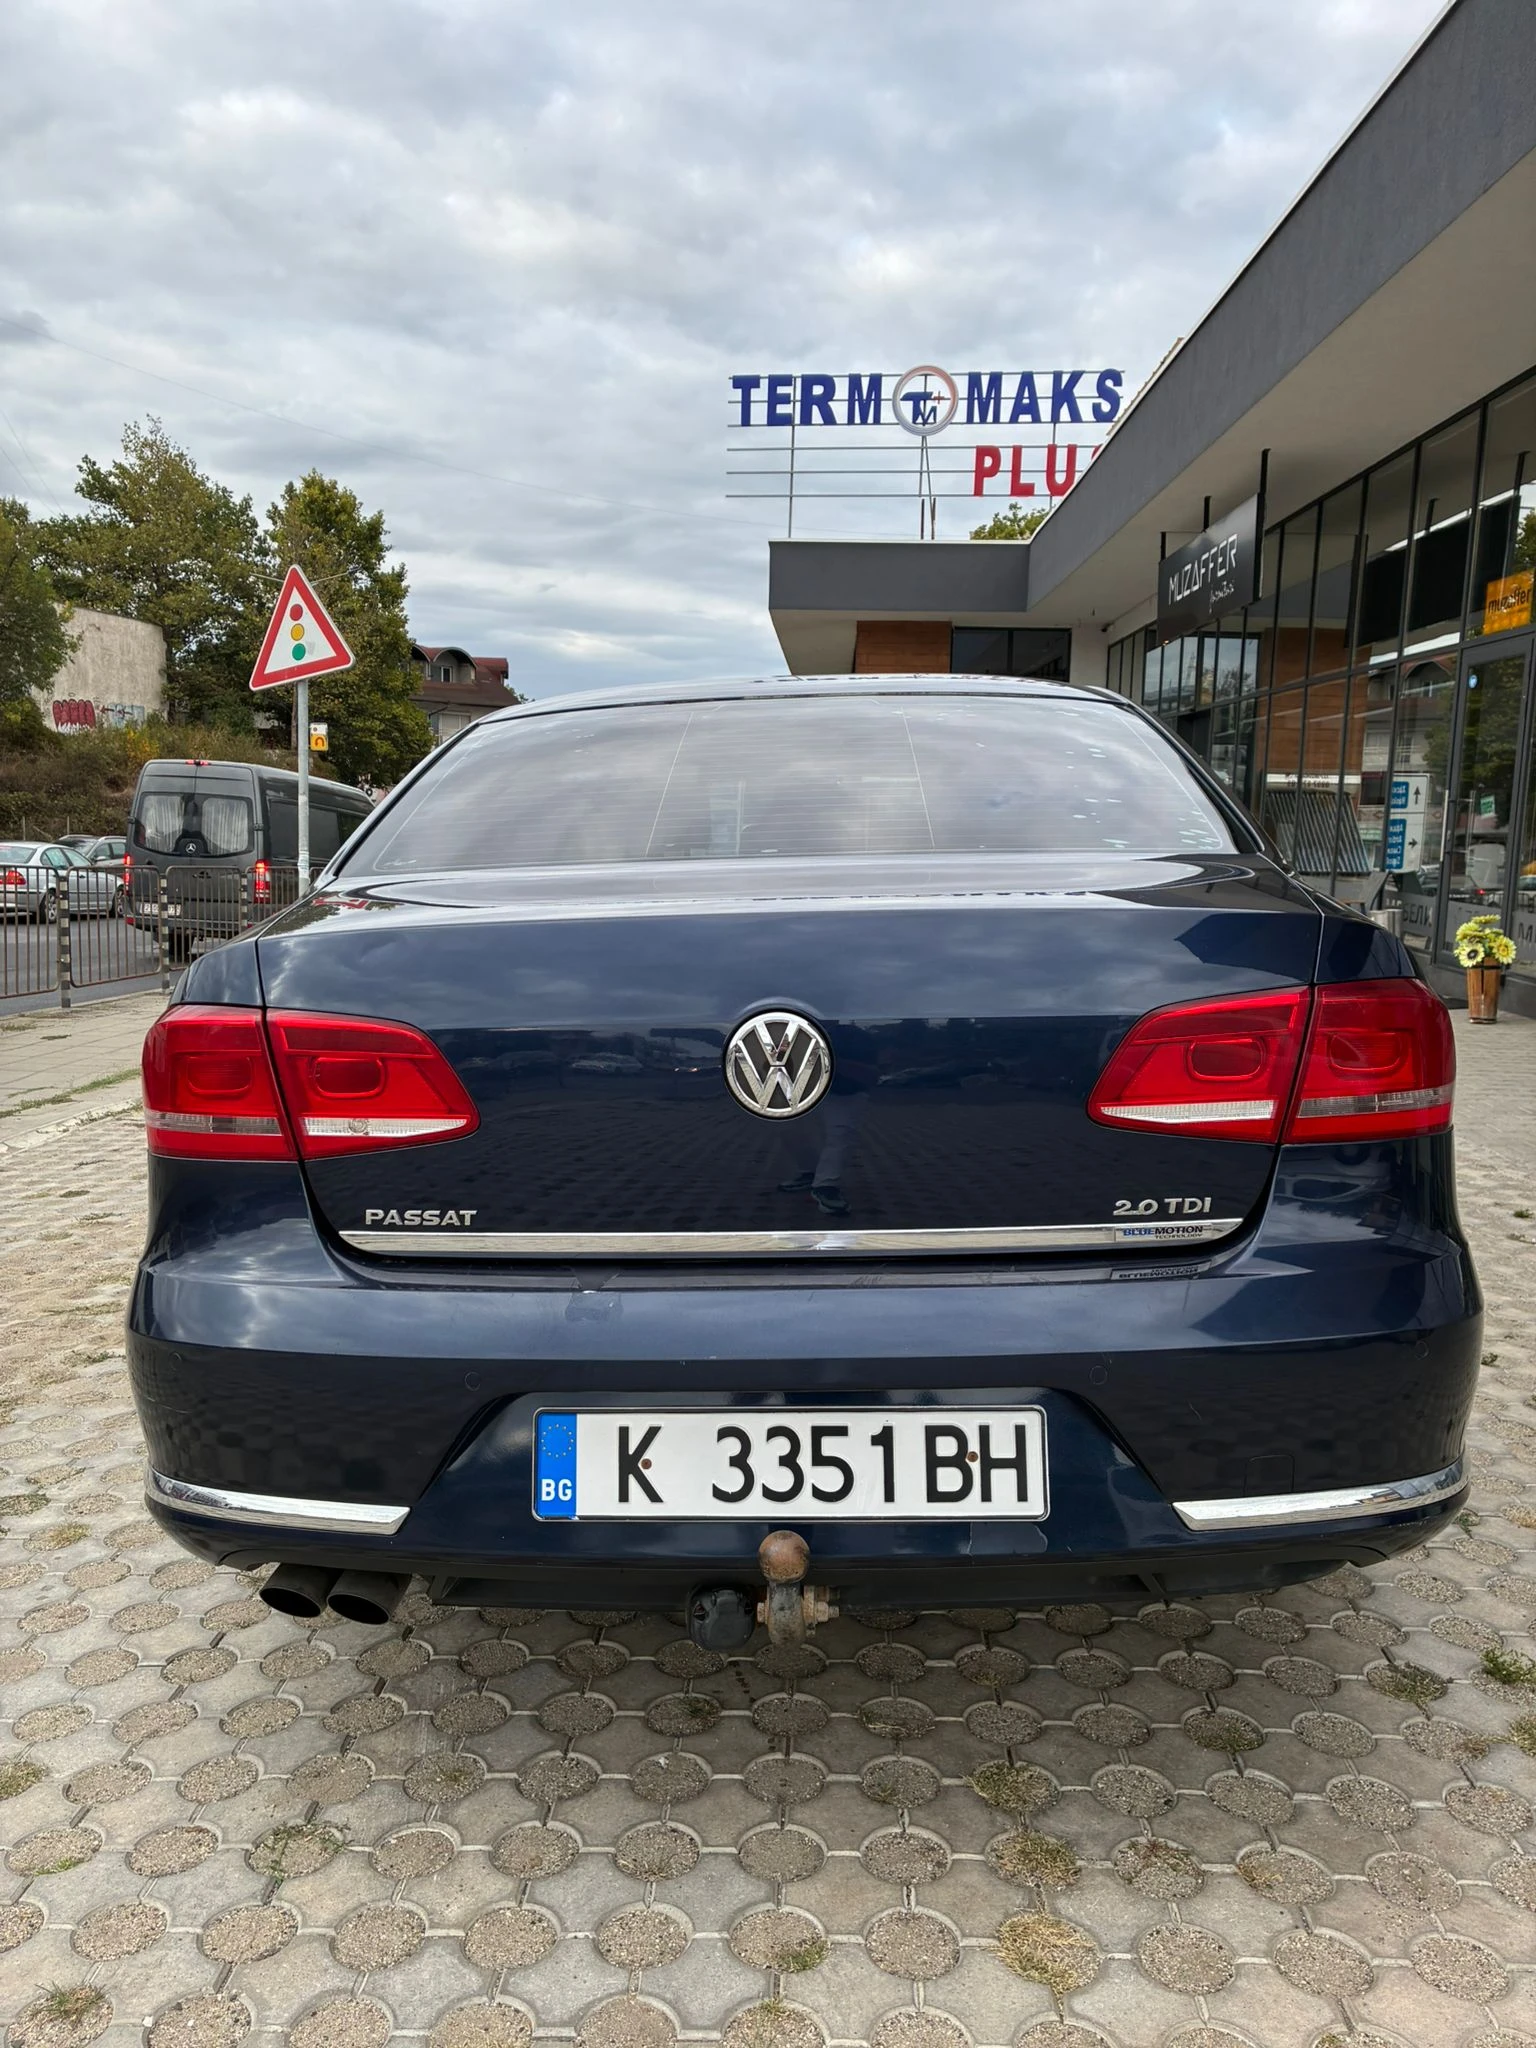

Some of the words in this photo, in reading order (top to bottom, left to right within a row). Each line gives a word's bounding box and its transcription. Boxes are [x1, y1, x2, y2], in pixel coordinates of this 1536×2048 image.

[966, 369, 1123, 423] MAKS
[973, 444, 1103, 497] PLU
[1168, 533, 1238, 606] MUZAFFER
[365, 1209, 478, 1226] PASSAT
[1164, 1197, 1212, 1214] TDI
[1123, 1225, 1204, 1237] BLUEMOTION
[617, 1426, 663, 1503] K
[712, 1425, 895, 1503] 3351
[926, 1425, 1029, 1503] BH
[541, 1479, 573, 1502] BG
